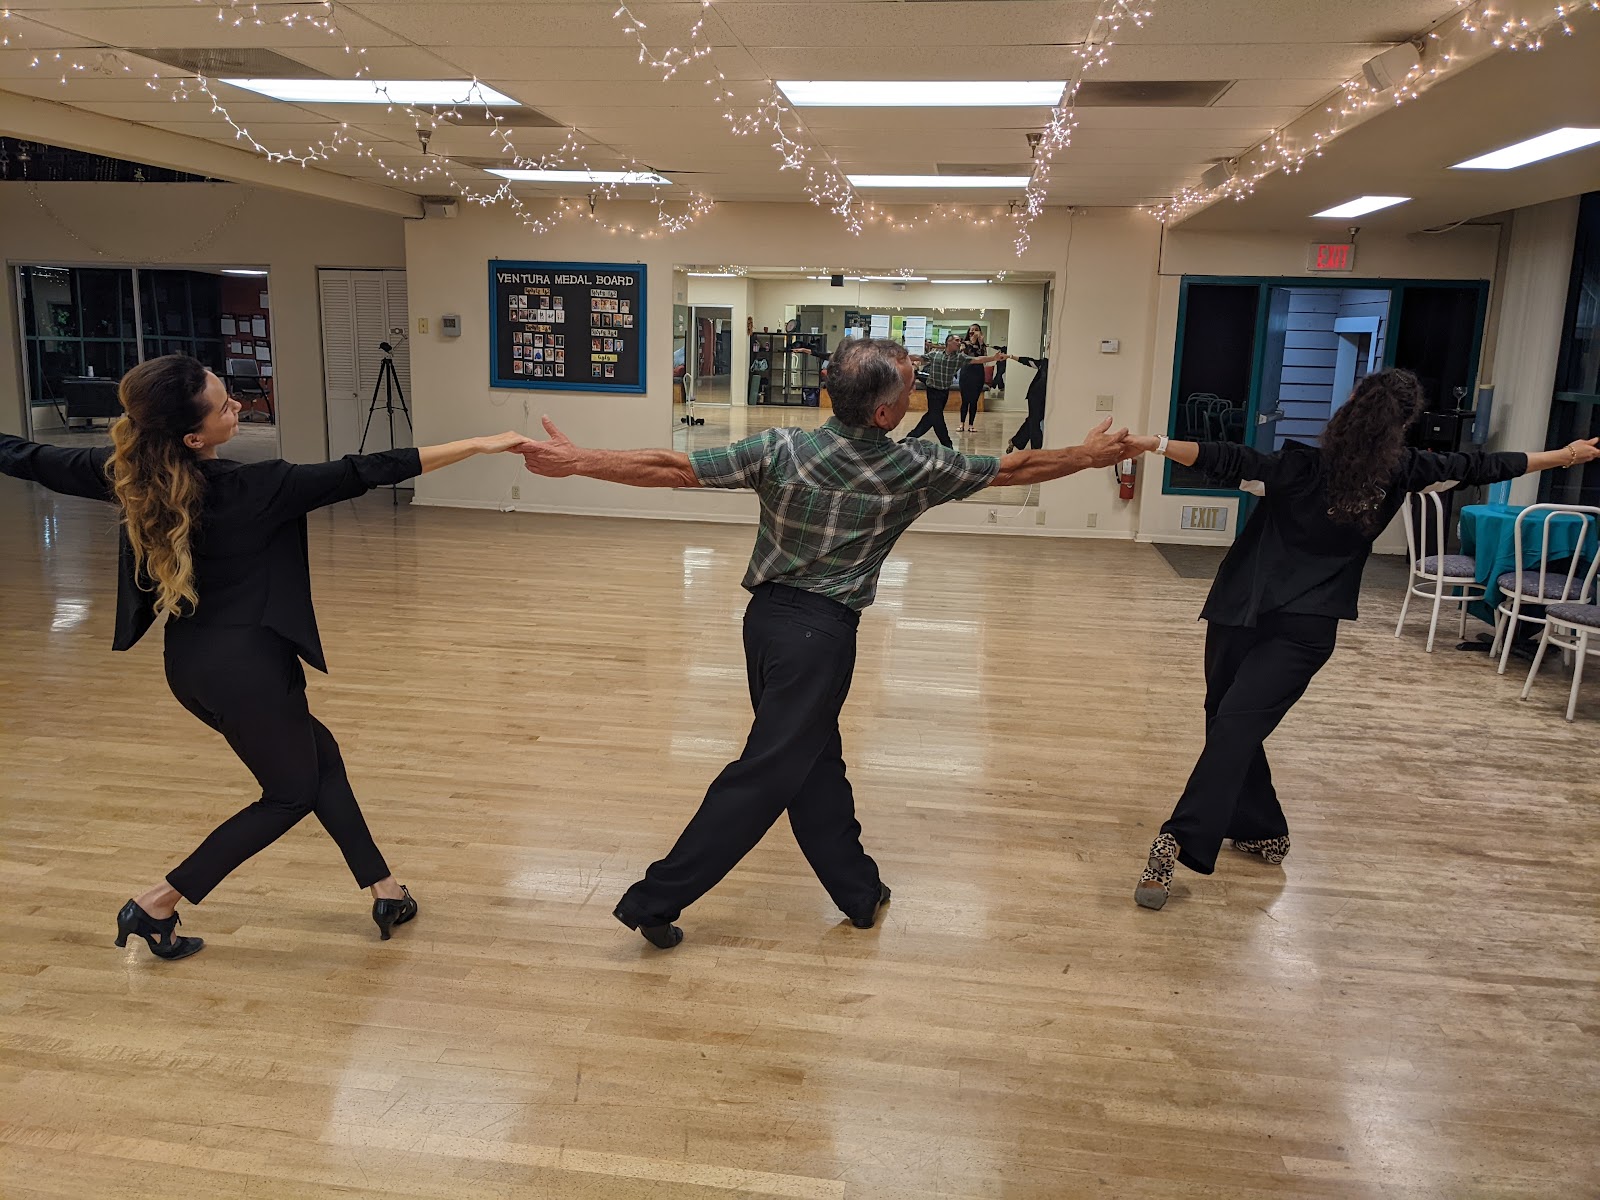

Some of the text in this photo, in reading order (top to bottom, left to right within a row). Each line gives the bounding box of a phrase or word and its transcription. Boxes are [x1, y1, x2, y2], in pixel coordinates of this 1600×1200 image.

[1317, 244, 1350, 269] EXIT
[497, 273, 634, 286] VENTURA MEDAL BOARD
[1190, 508, 1219, 528] EXIT
